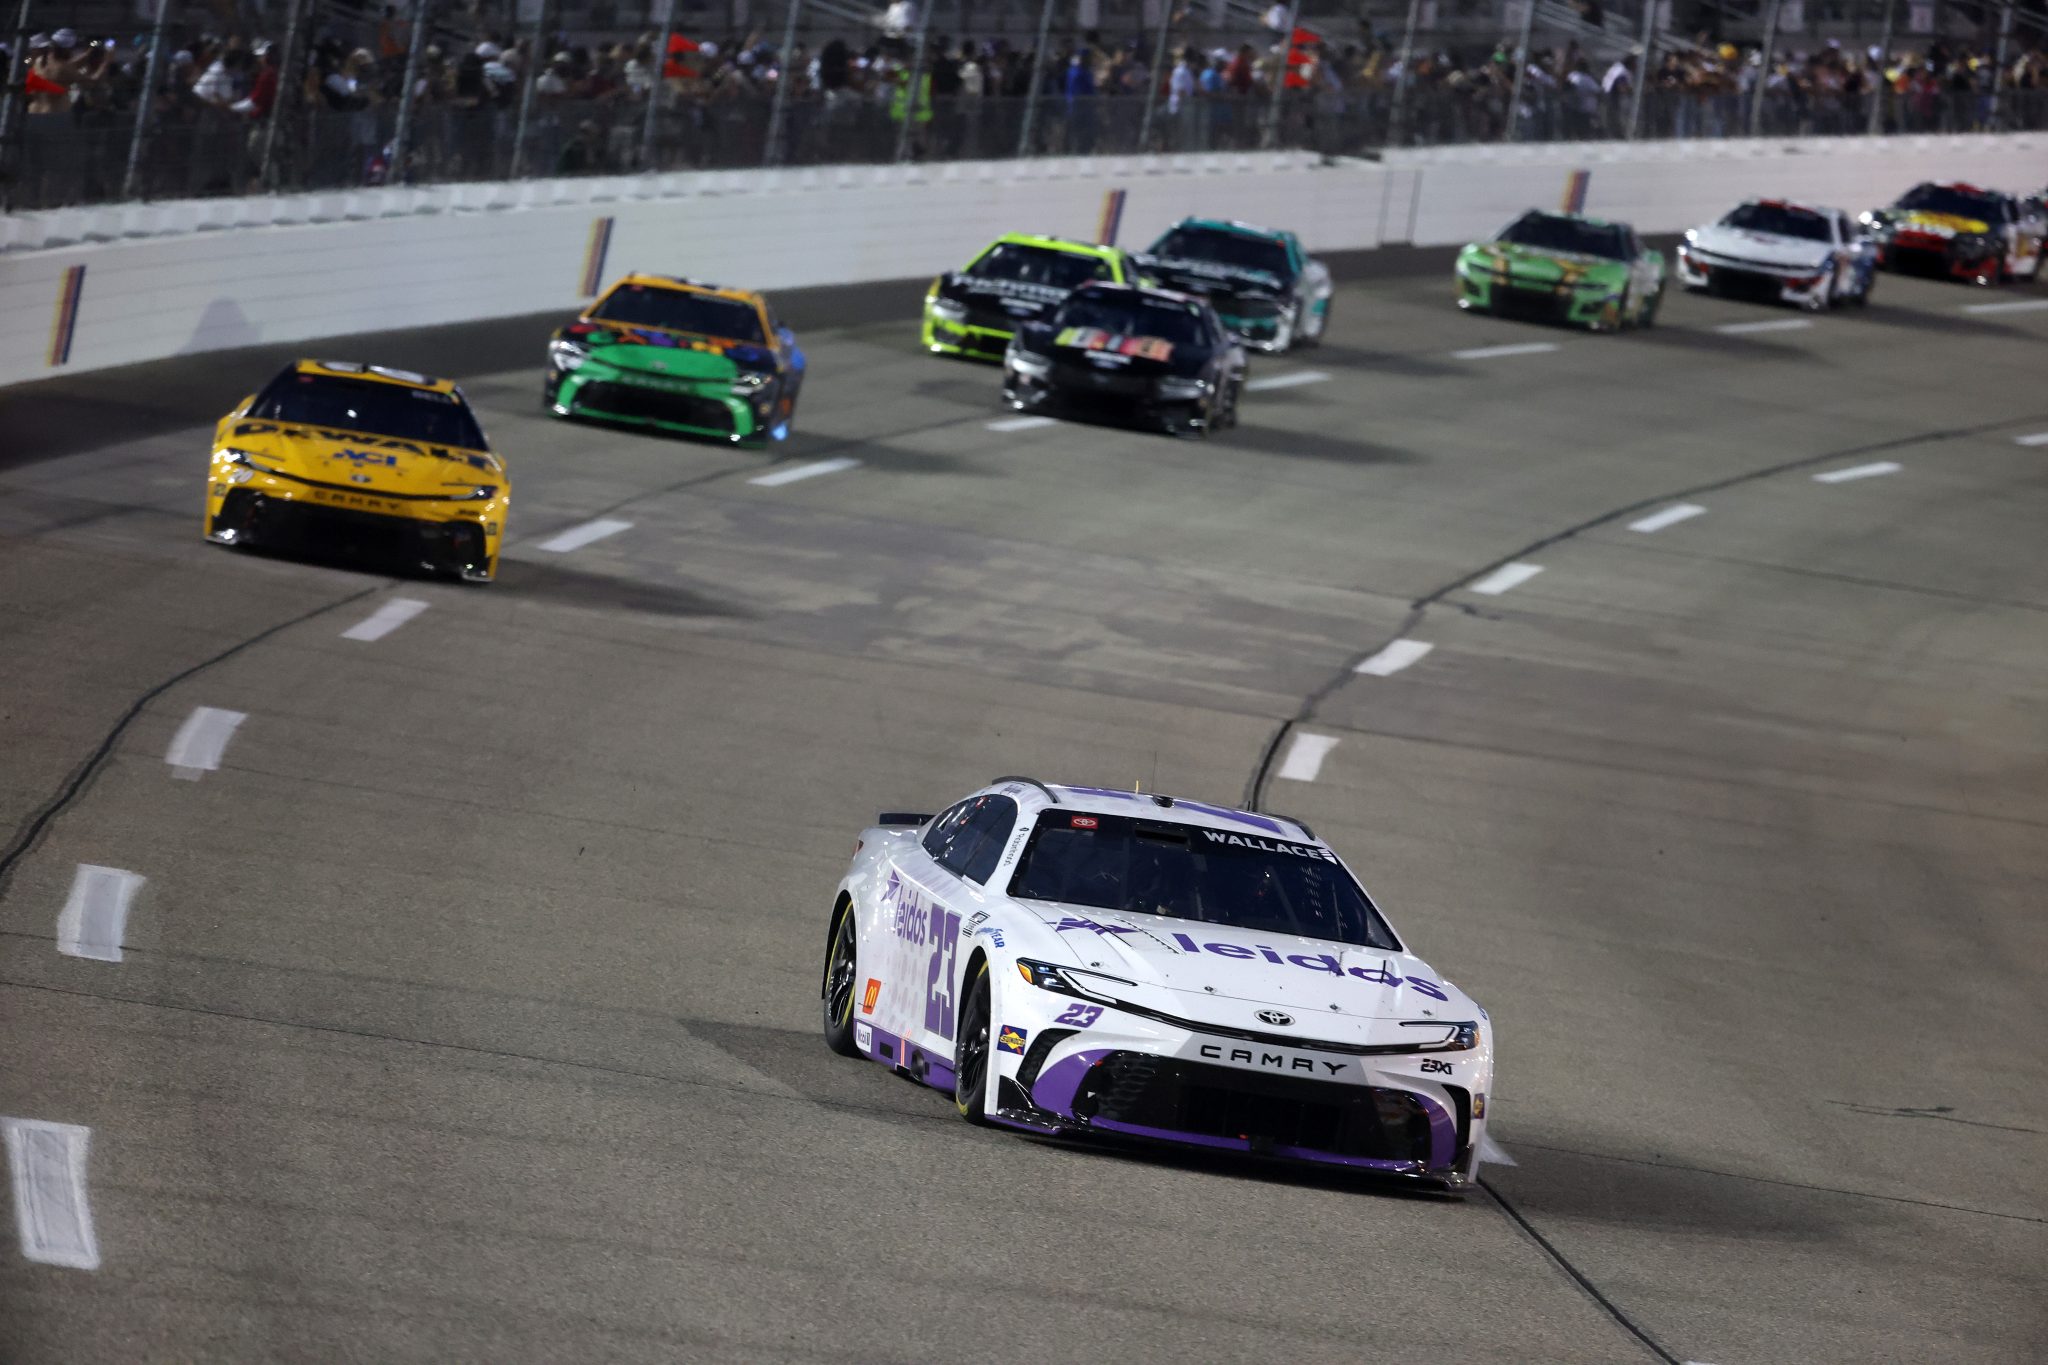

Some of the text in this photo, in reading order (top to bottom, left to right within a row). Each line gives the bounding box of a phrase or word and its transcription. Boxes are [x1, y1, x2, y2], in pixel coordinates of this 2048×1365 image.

[1202, 830, 1323, 860] WALLACE
[893, 884, 928, 947] leidos
[975, 927, 1005, 949] YEAR
[924, 902, 963, 1042] 23
[1171, 932, 1450, 1002] leidos
[1054, 1003, 1104, 1028] 23
[1200, 1044, 1348, 1076] CAMRY
